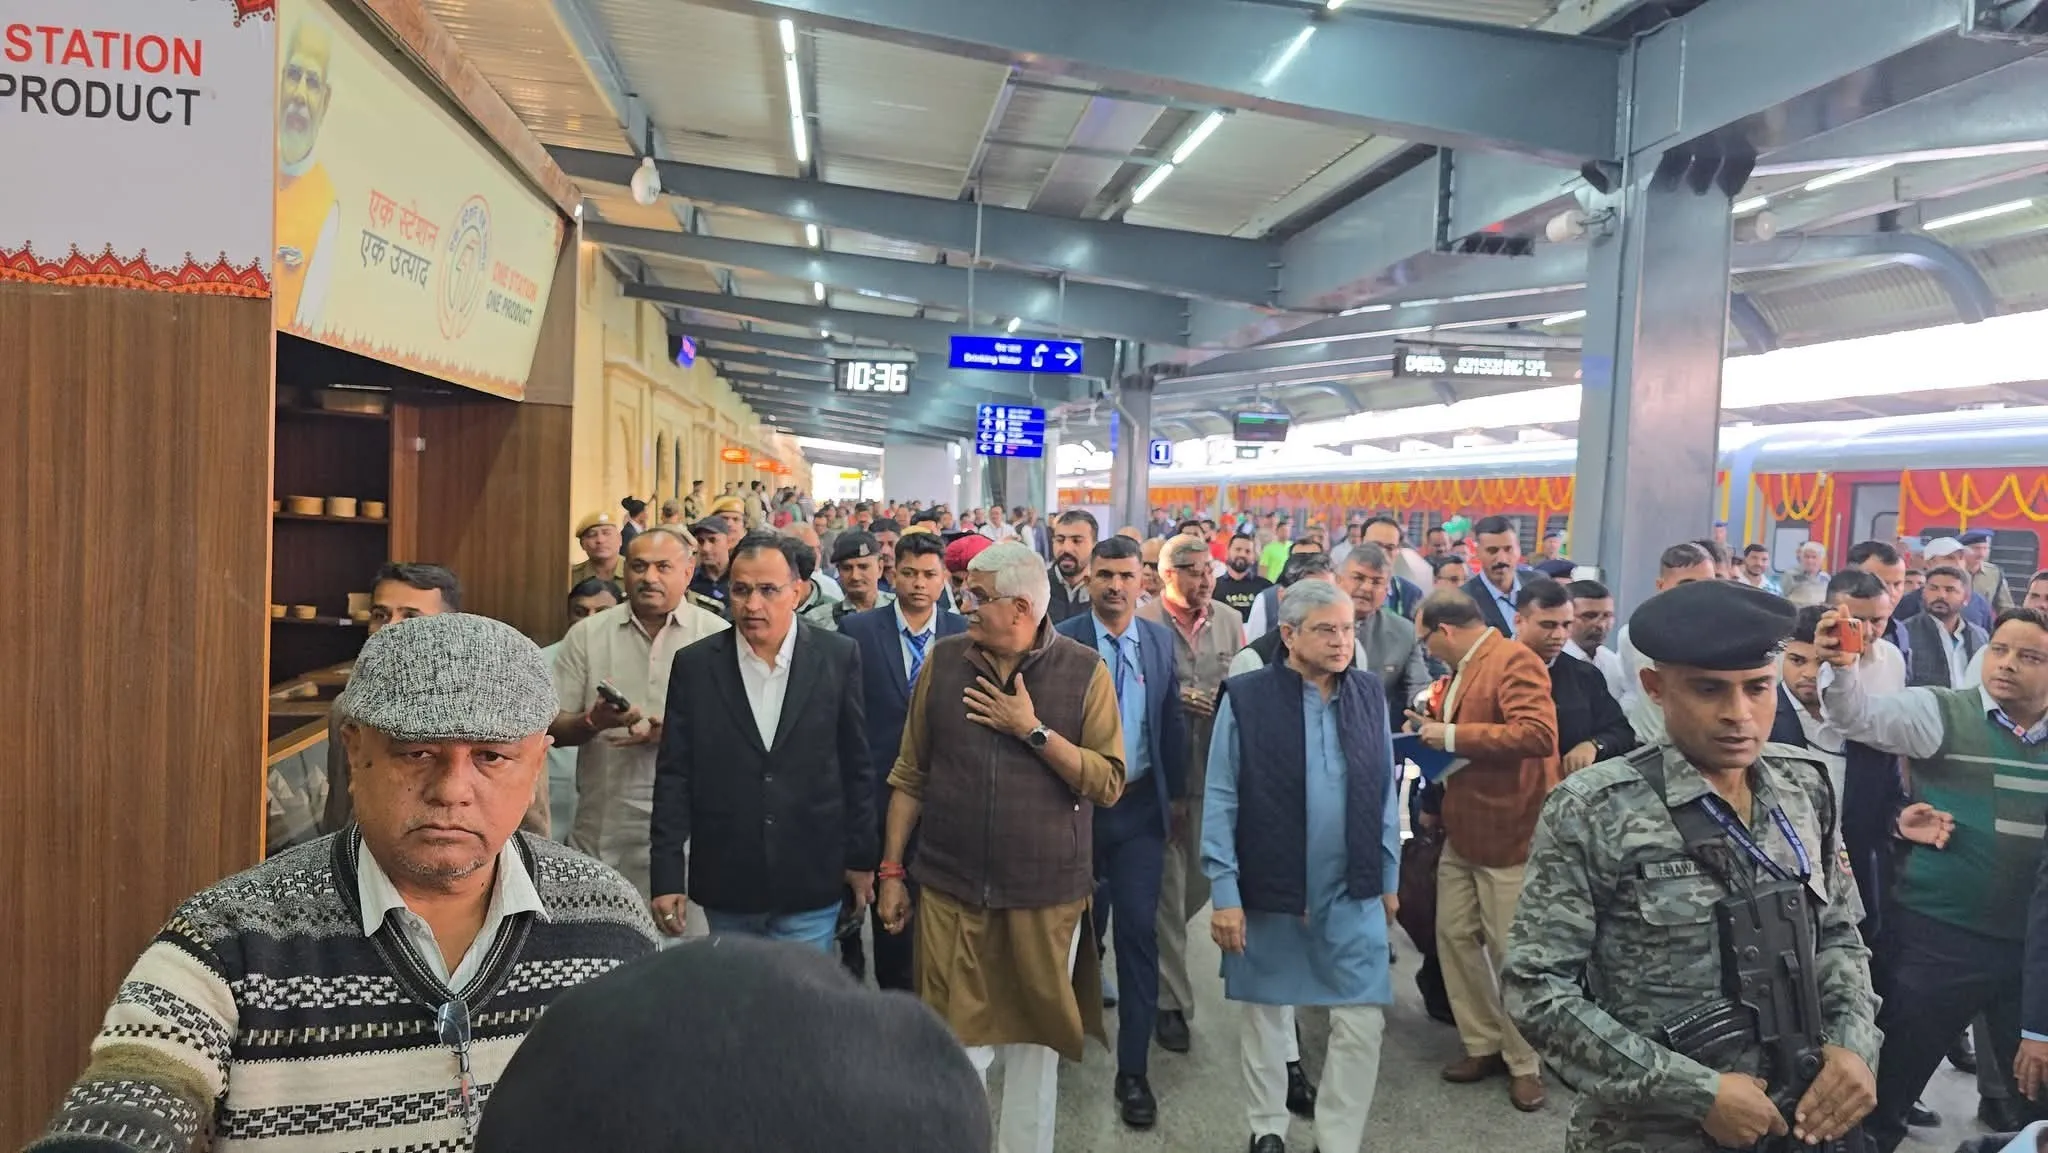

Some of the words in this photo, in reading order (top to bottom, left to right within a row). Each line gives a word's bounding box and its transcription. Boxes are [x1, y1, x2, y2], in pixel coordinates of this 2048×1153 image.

[4, 23, 201, 77] STATION
[0, 73, 200, 126] PRODUCT
[369, 189, 397, 228] एक
[398, 200, 440, 252] स्टेशन
[361, 229, 389, 268] एक
[390, 244, 431, 289] उत्पाद
[492, 261, 509, 288] ONE
[486, 289, 502, 316] ONE
[501, 295, 533, 326] PRODUCT
[846, 362, 908, 392] 10:36
